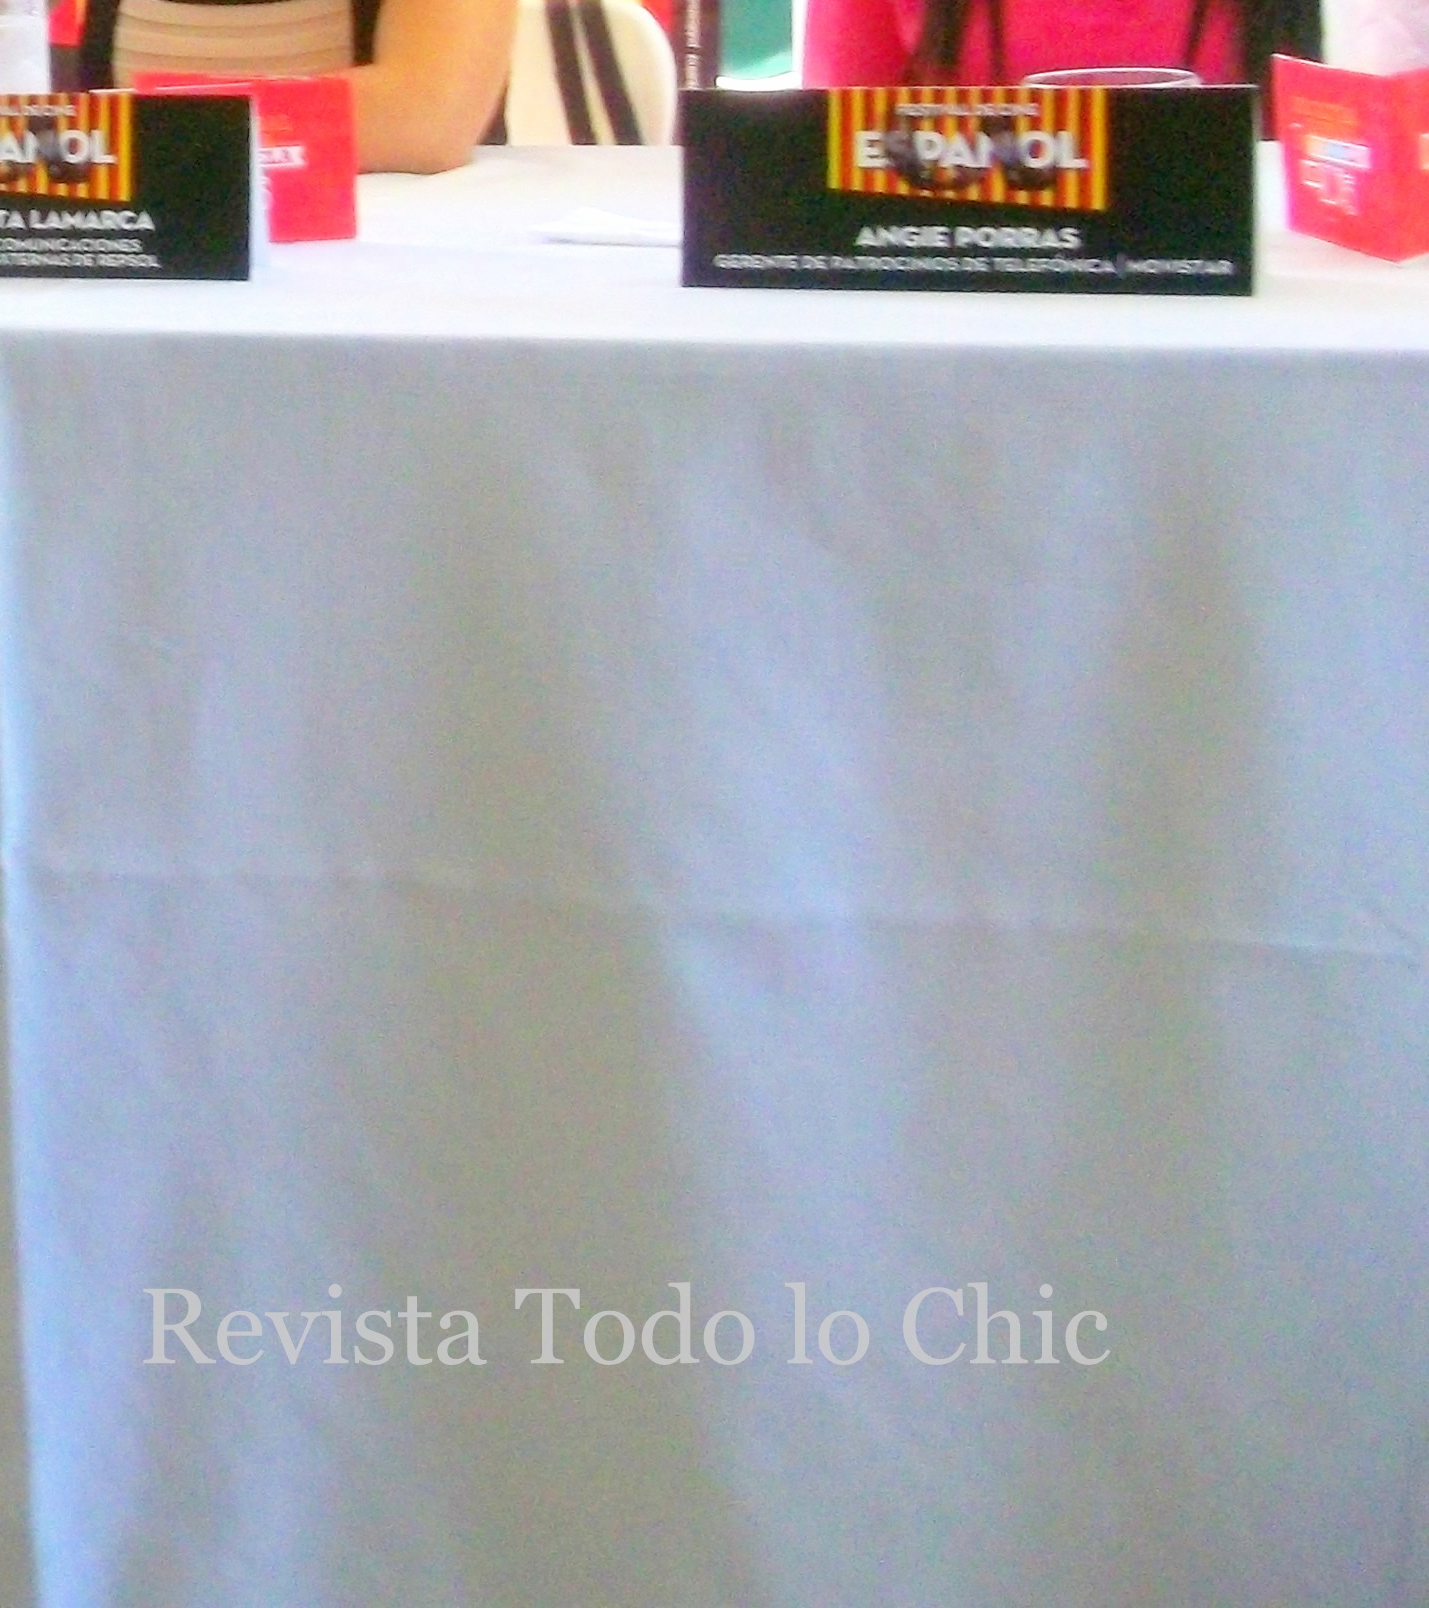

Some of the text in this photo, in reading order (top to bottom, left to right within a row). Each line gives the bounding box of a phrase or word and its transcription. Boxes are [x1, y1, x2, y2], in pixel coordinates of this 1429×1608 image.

[29, 209, 156, 232] LAMARCA
[854, 225, 1083, 250] ANGIE PORRAS
[712, 253, 797, 271] GERENTE
[800, 255, 829, 271] DE
[961, 256, 993, 273] DE
